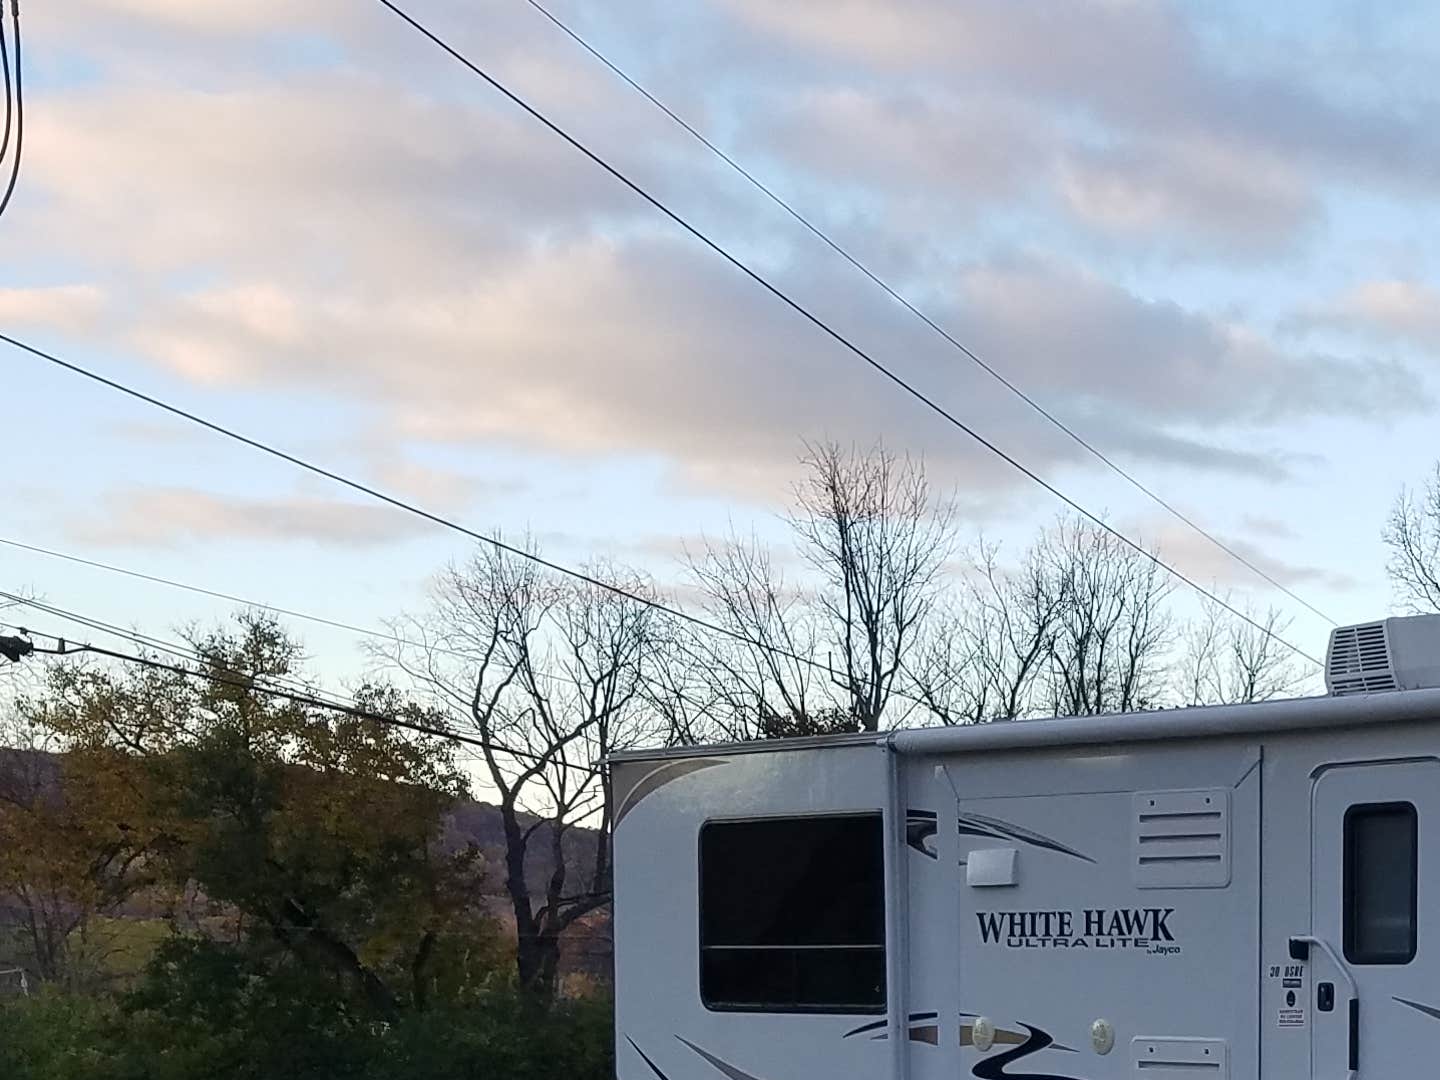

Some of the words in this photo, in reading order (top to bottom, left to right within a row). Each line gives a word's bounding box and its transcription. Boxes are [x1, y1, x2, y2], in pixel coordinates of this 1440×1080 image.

[976, 911, 1073, 943] WHITE
[1083, 908, 1175, 941] HAWK
[1007, 938, 1089, 948] ULTRA
[1095, 938, 1149, 948] LITE
[1152, 944, 1181, 955] Jayco
